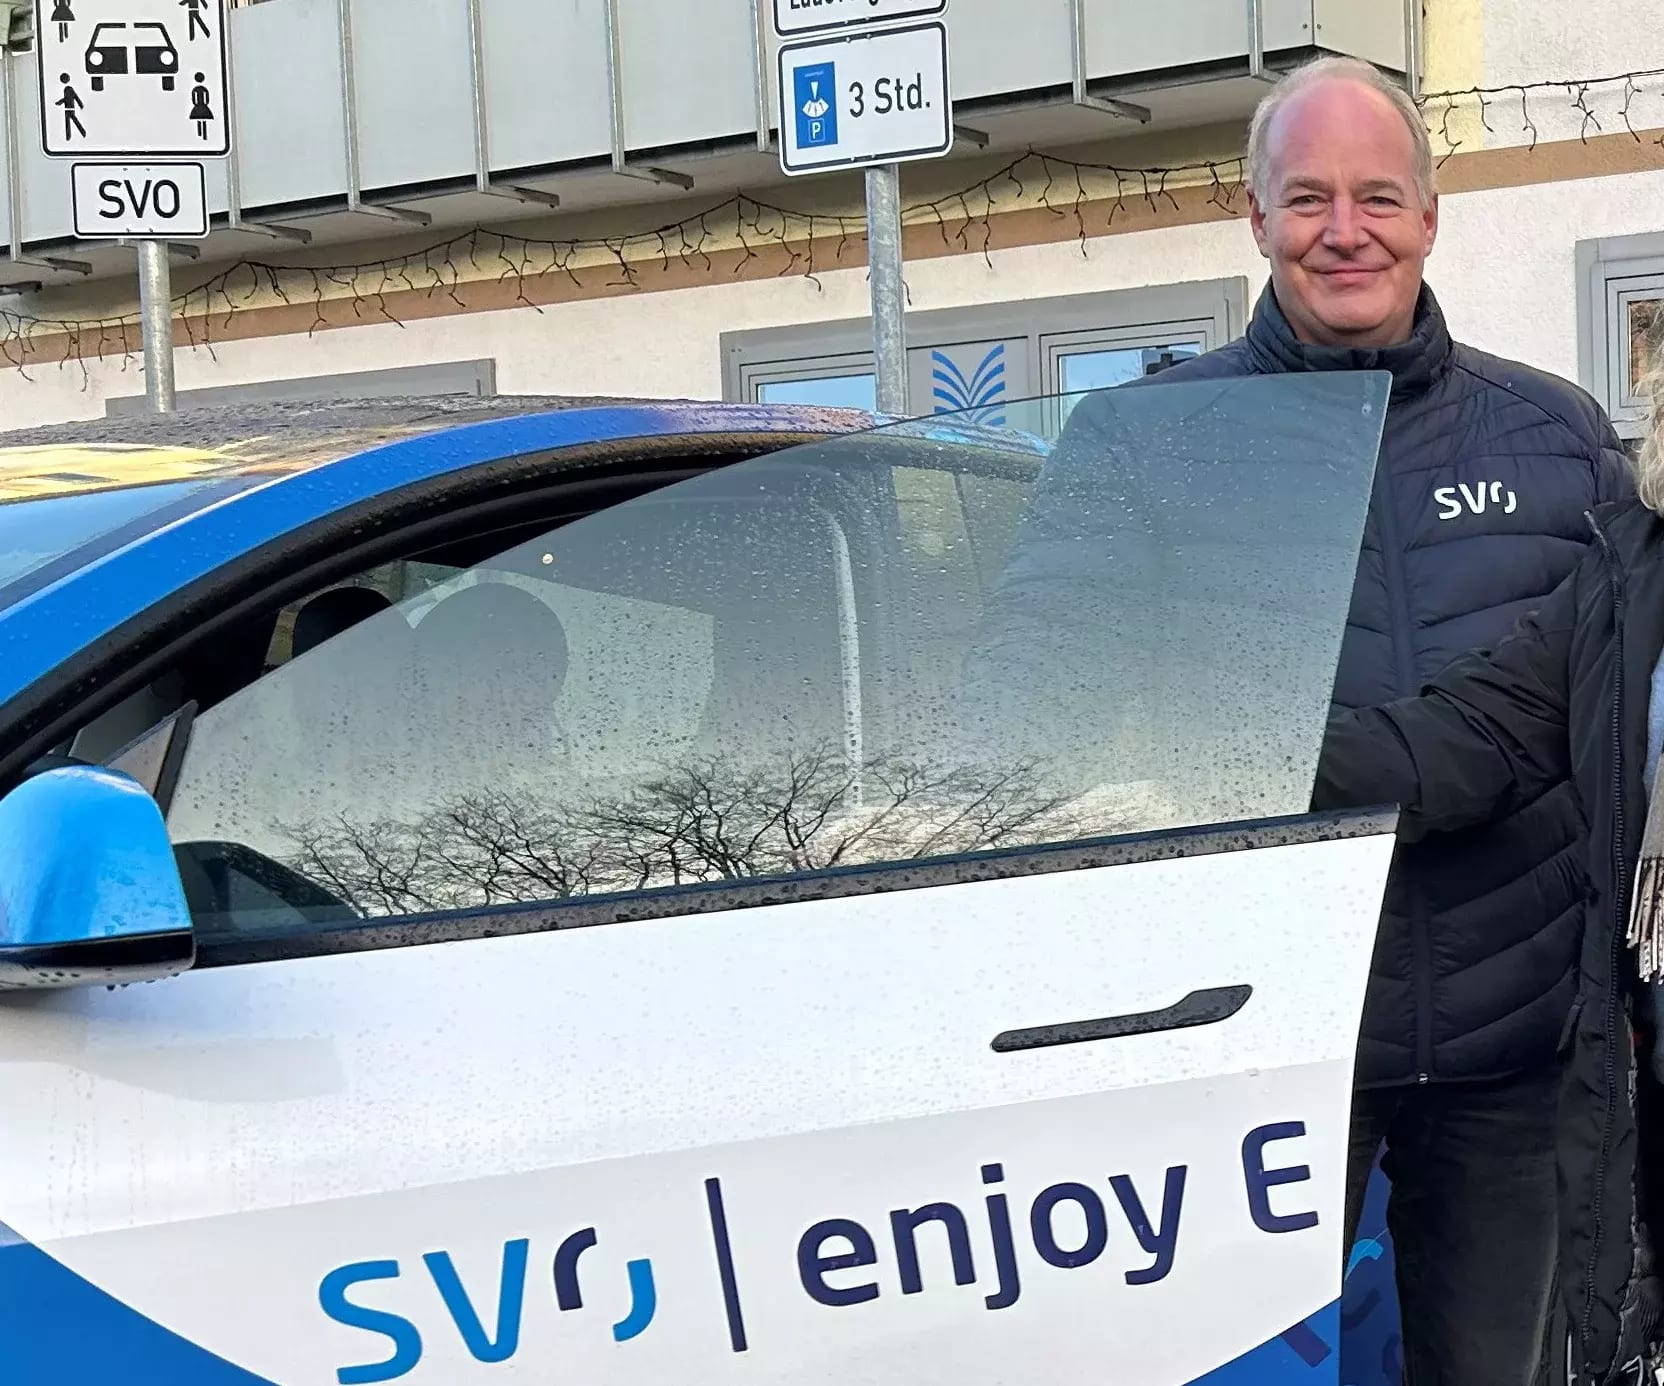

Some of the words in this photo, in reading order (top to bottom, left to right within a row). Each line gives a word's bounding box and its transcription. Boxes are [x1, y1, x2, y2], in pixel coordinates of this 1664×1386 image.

[849, 81, 864, 118] 3
[874, 72, 931, 115] Std.
[811, 121, 821, 140] P
[98, 179, 181, 219] SVO
[1433, 480, 1518, 520] SVO
[318, 1227, 657, 1386] SVO
[798, 1163, 1188, 1310] enjoy
[1240, 1121, 1320, 1234] E
